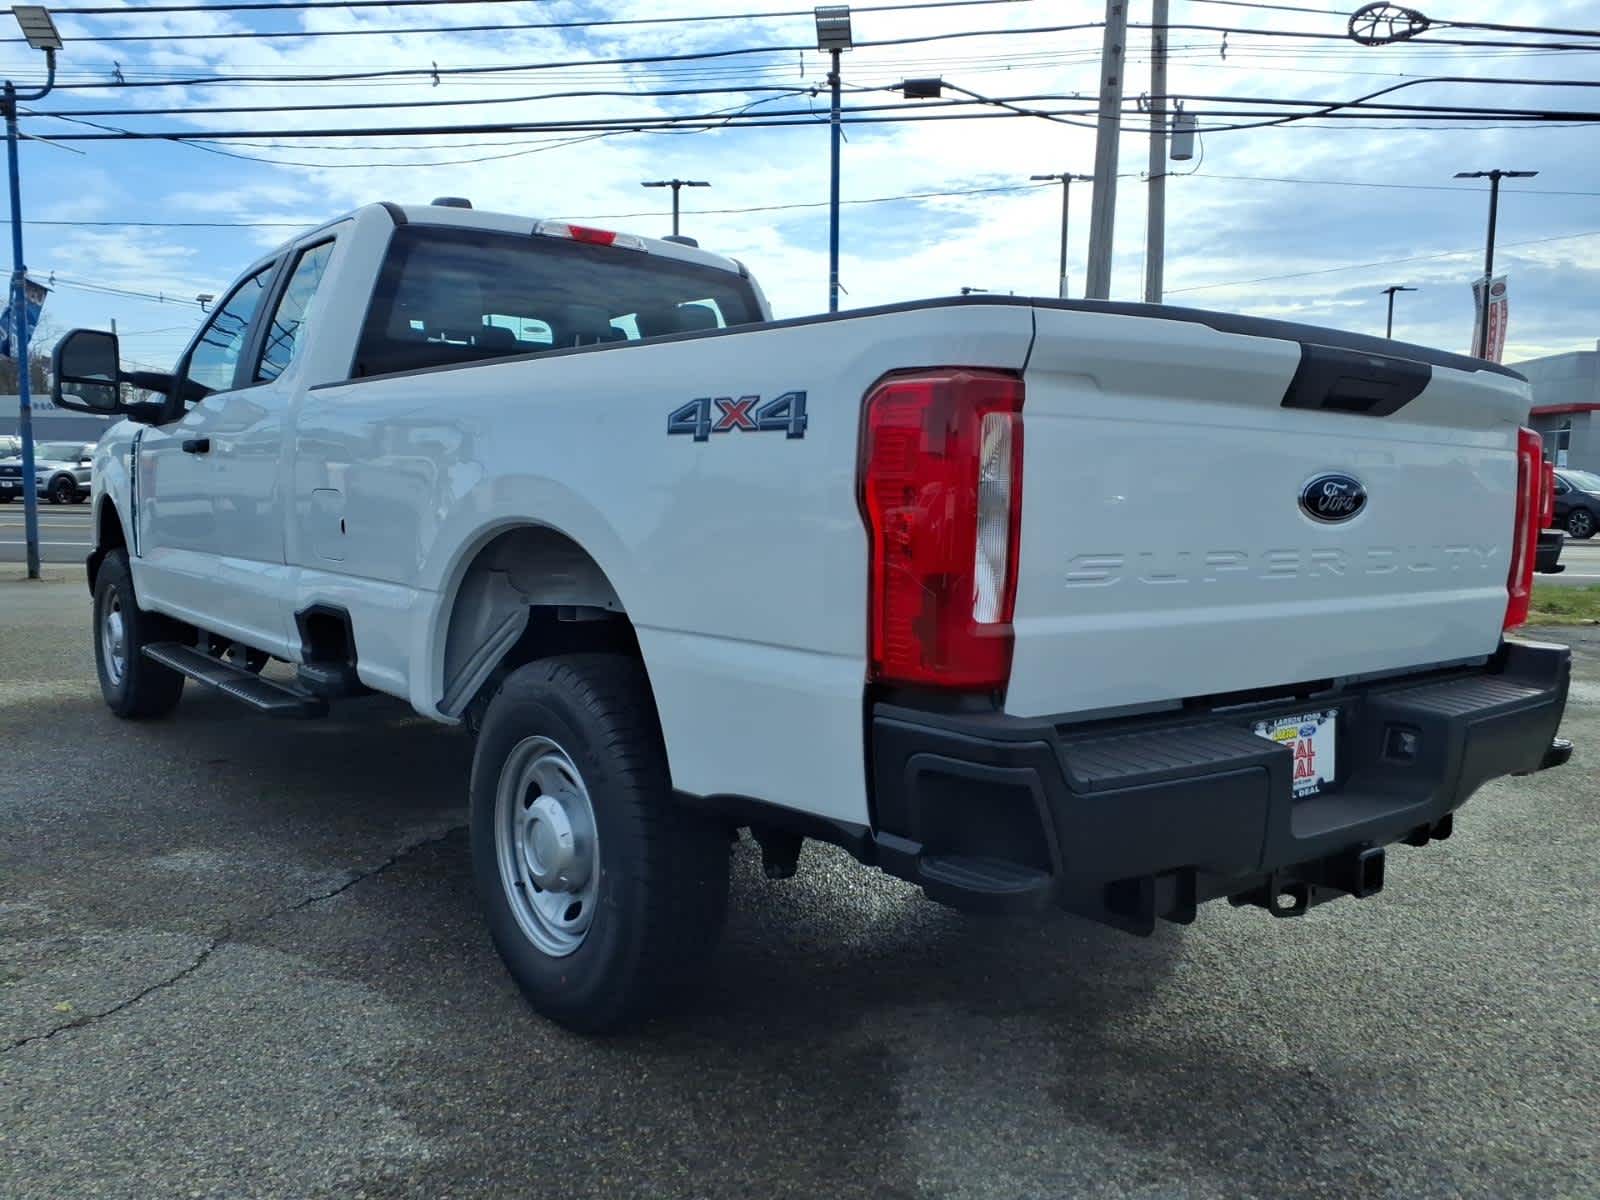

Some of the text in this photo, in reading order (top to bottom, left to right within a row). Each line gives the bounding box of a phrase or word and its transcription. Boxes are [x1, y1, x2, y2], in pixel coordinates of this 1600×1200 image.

[1318, 481, 1357, 511] Ford
[1064, 544, 1497, 589] SUPER DUTY
